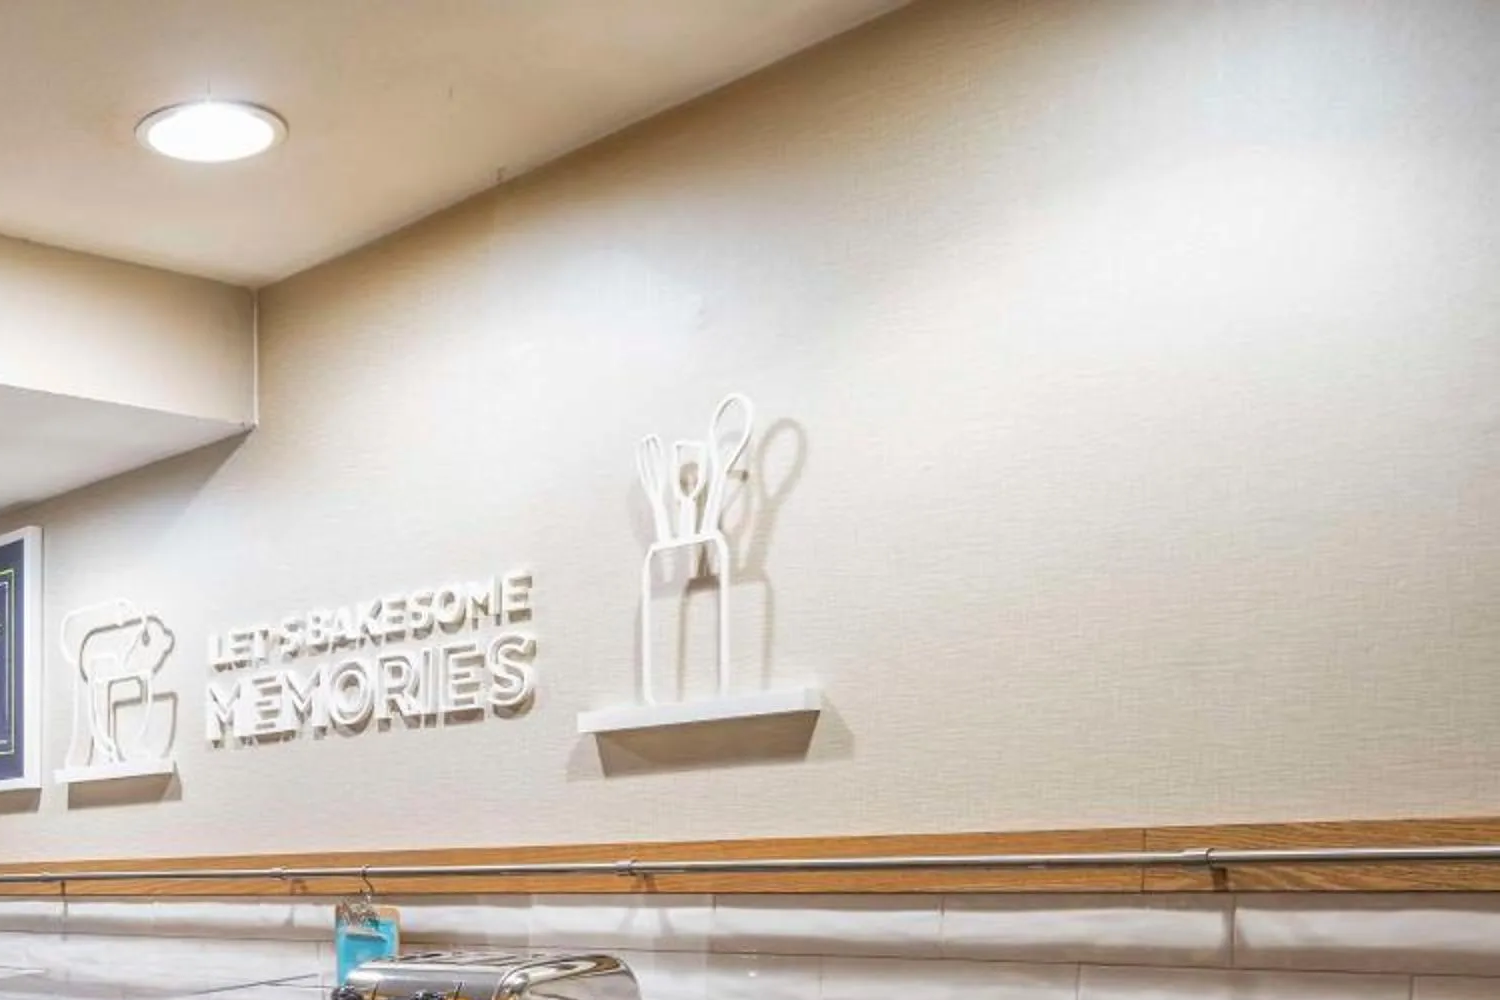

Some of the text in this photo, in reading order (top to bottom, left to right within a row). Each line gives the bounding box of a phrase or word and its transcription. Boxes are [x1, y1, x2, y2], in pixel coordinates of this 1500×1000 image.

[306, 596, 407, 648] BAKE
[408, 572, 534, 634] SOME
[205, 631, 537, 741] MEMORIES
